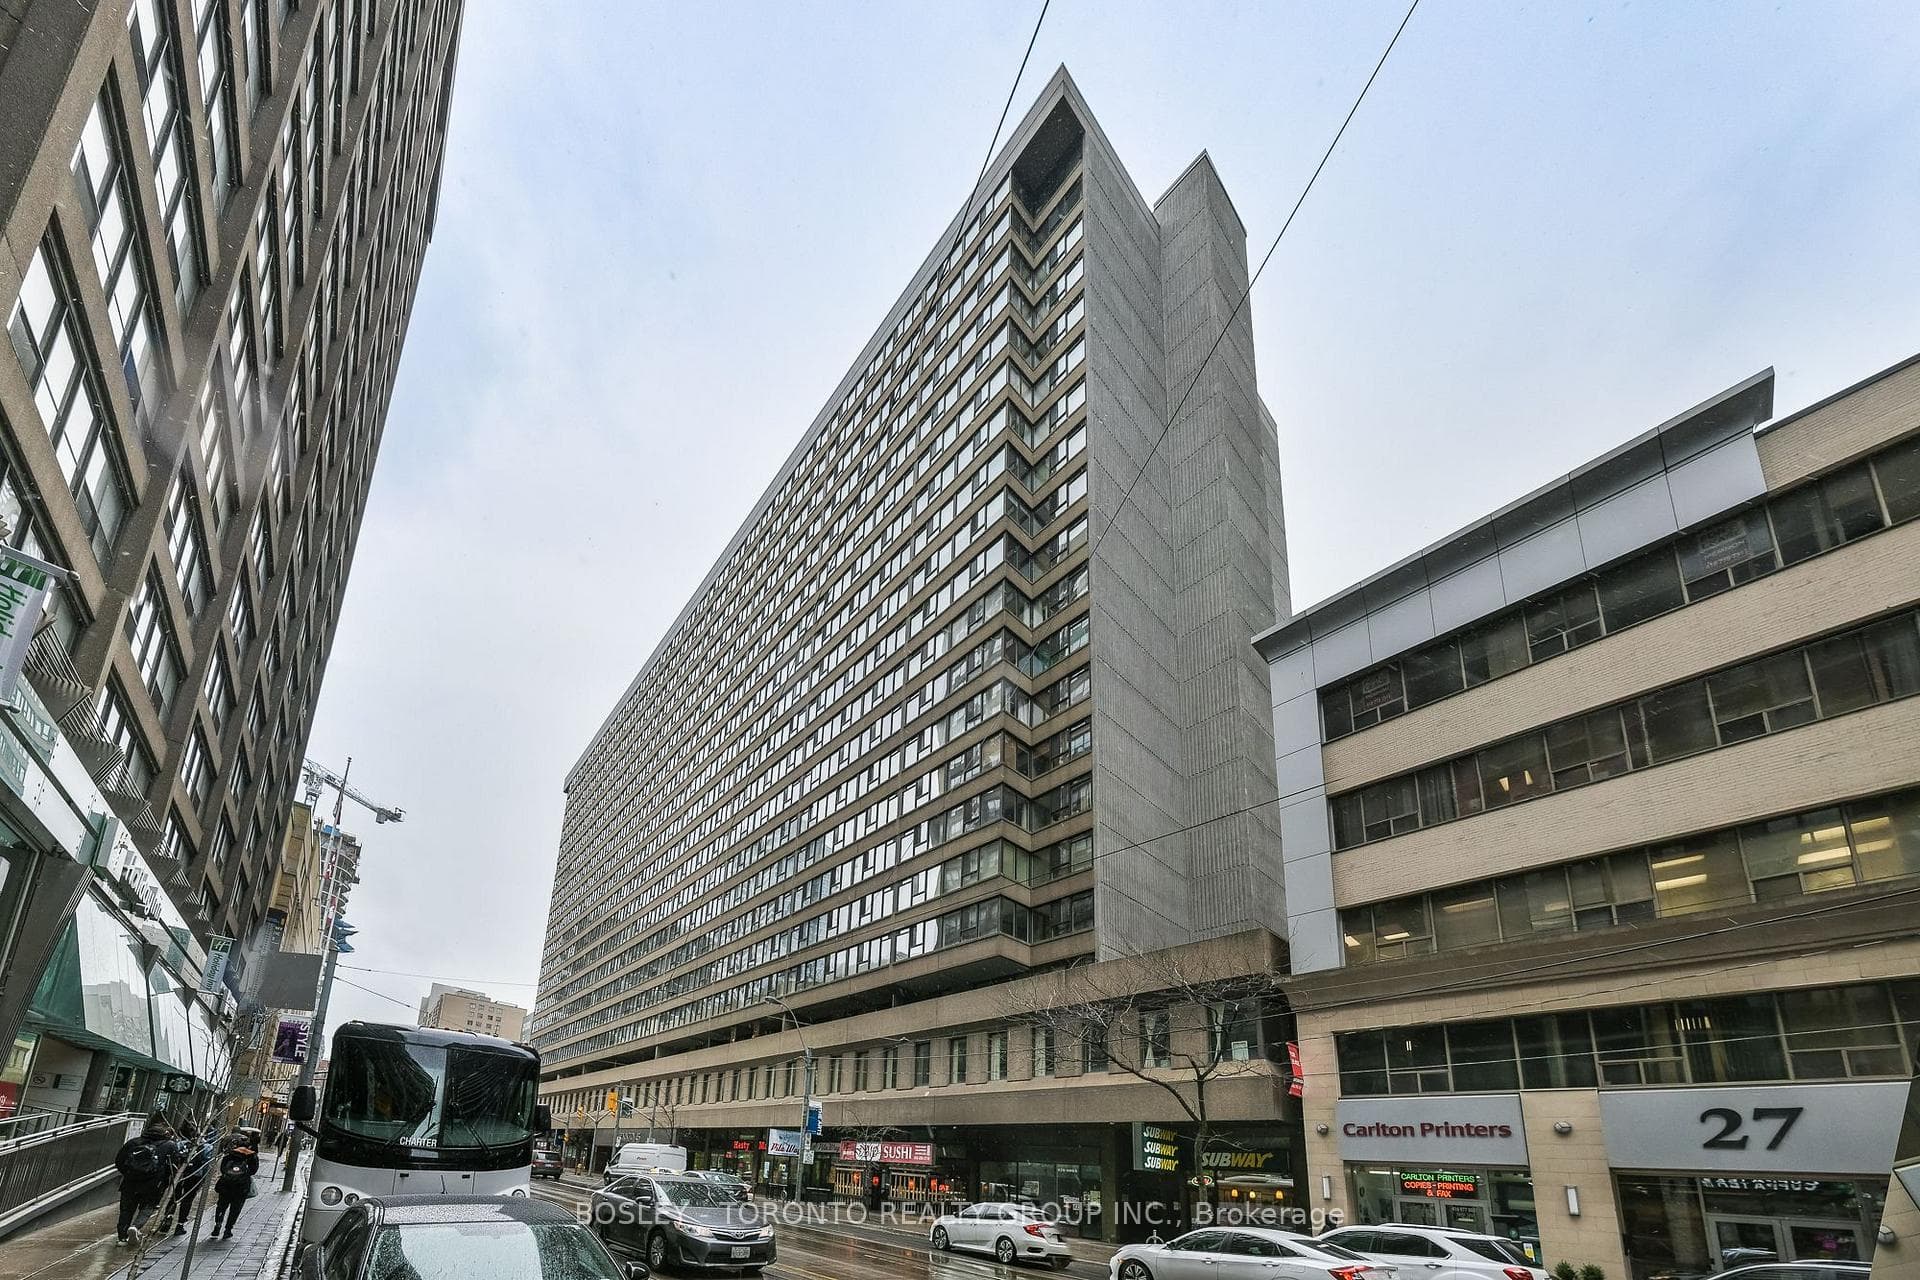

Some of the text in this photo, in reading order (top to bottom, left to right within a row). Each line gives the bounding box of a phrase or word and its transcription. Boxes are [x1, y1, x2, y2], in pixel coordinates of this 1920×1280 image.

[207, 952, 224, 980] Holiday
[294, 1024, 310, 1059] STYLE
[1143, 1126, 1179, 1142] SUBWAY
[1343, 1121, 1513, 1139] Carlton Printers
[1700, 1107, 1804, 1151] 27
[399, 1136, 438, 1148] CHARTER
[1144, 1141, 1179, 1157] SUBWAY
[883, 1145, 913, 1160] SUSHI
[1201, 1152, 1274, 1168] SUBWAY
[1144, 1156, 1179, 1171] SUBWAY
[1401, 1173, 1475, 1183] CARLTON PRINTERS
[1427, 1189, 1452, 1198] & FAX
